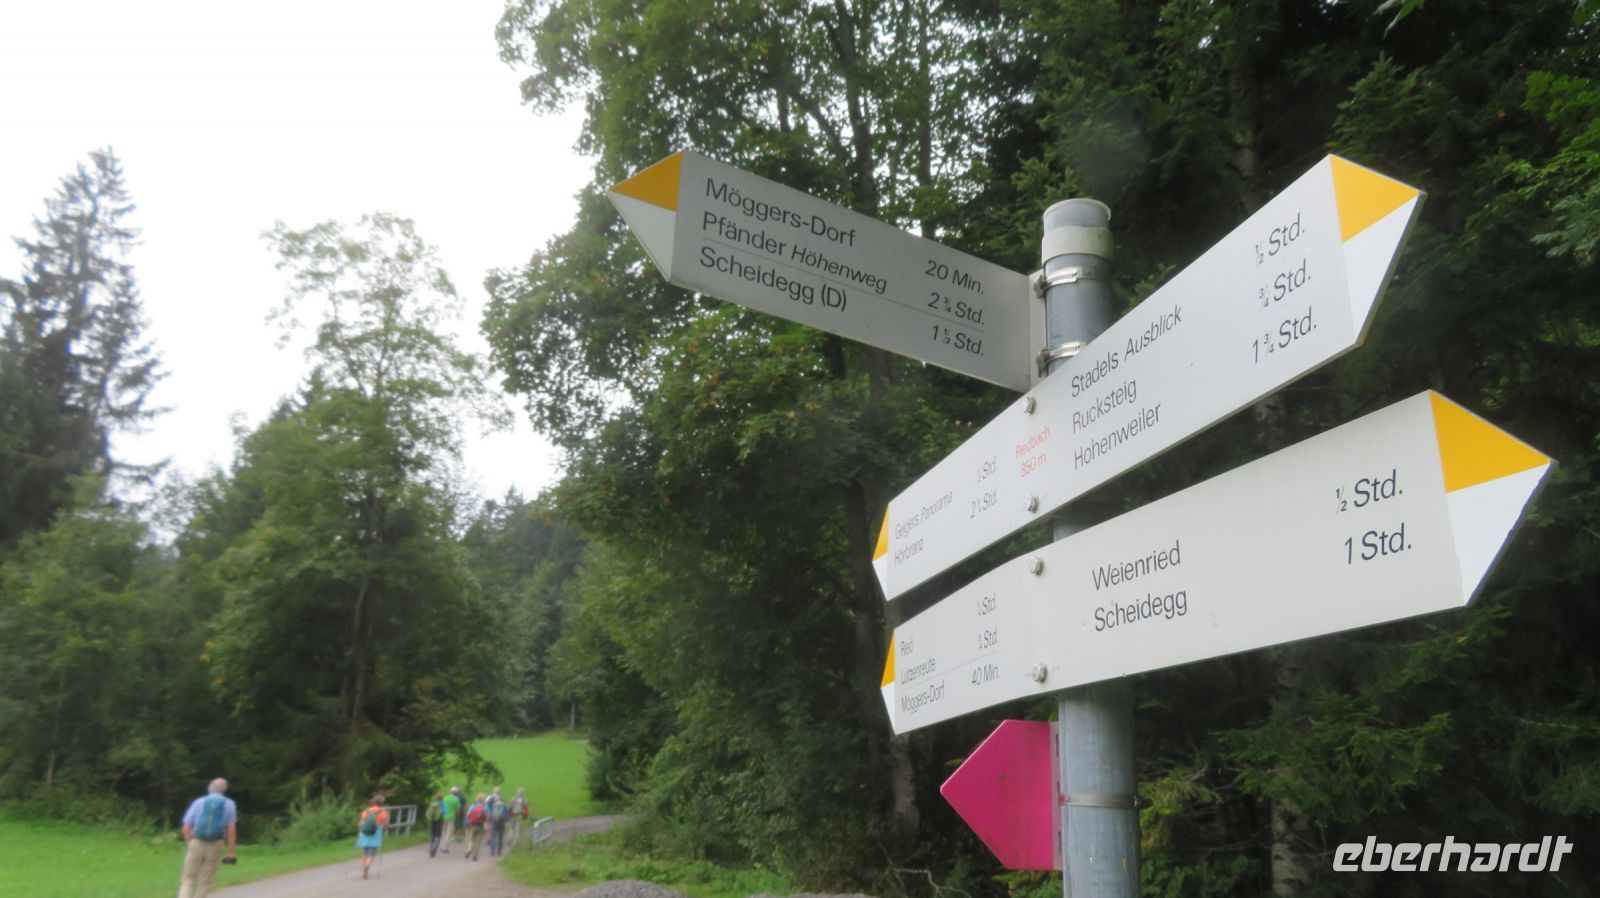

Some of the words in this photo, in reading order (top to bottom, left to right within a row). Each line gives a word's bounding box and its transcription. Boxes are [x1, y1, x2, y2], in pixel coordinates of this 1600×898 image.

[703, 211, 787, 256] Pfänder
[791, 244, 887, 294] Höhenweg
[955, 301, 984, 325] Std.
[706, 178, 856, 247] Möggers-Dorf
[925, 260, 948, 280] 20
[952, 269, 984, 294] Min.
[700, 247, 814, 305] Scheidegg
[821, 284, 847, 312] (D)
[954, 332, 984, 356] Std.
[1071, 351, 1119, 397] Stadels
[1124, 304, 1182, 361] Ausblick
[1268, 212, 1305, 256] Std.
[1072, 379, 1137, 433] Rucksteig
[1273, 258, 1311, 301] Std.
[1074, 404, 1161, 470] Hohenweiler
[1278, 305, 1317, 349] Std.
[921, 491, 953, 522] Panorama
[1092, 539, 1180, 590] Weienried
[1354, 469, 1403, 507] Std.
[1094, 590, 1187, 631] Scheidegg
[1345, 537, 1352, 564] 1
[1361, 522, 1411, 560] Std.
[971, 667, 981, 686] 40
